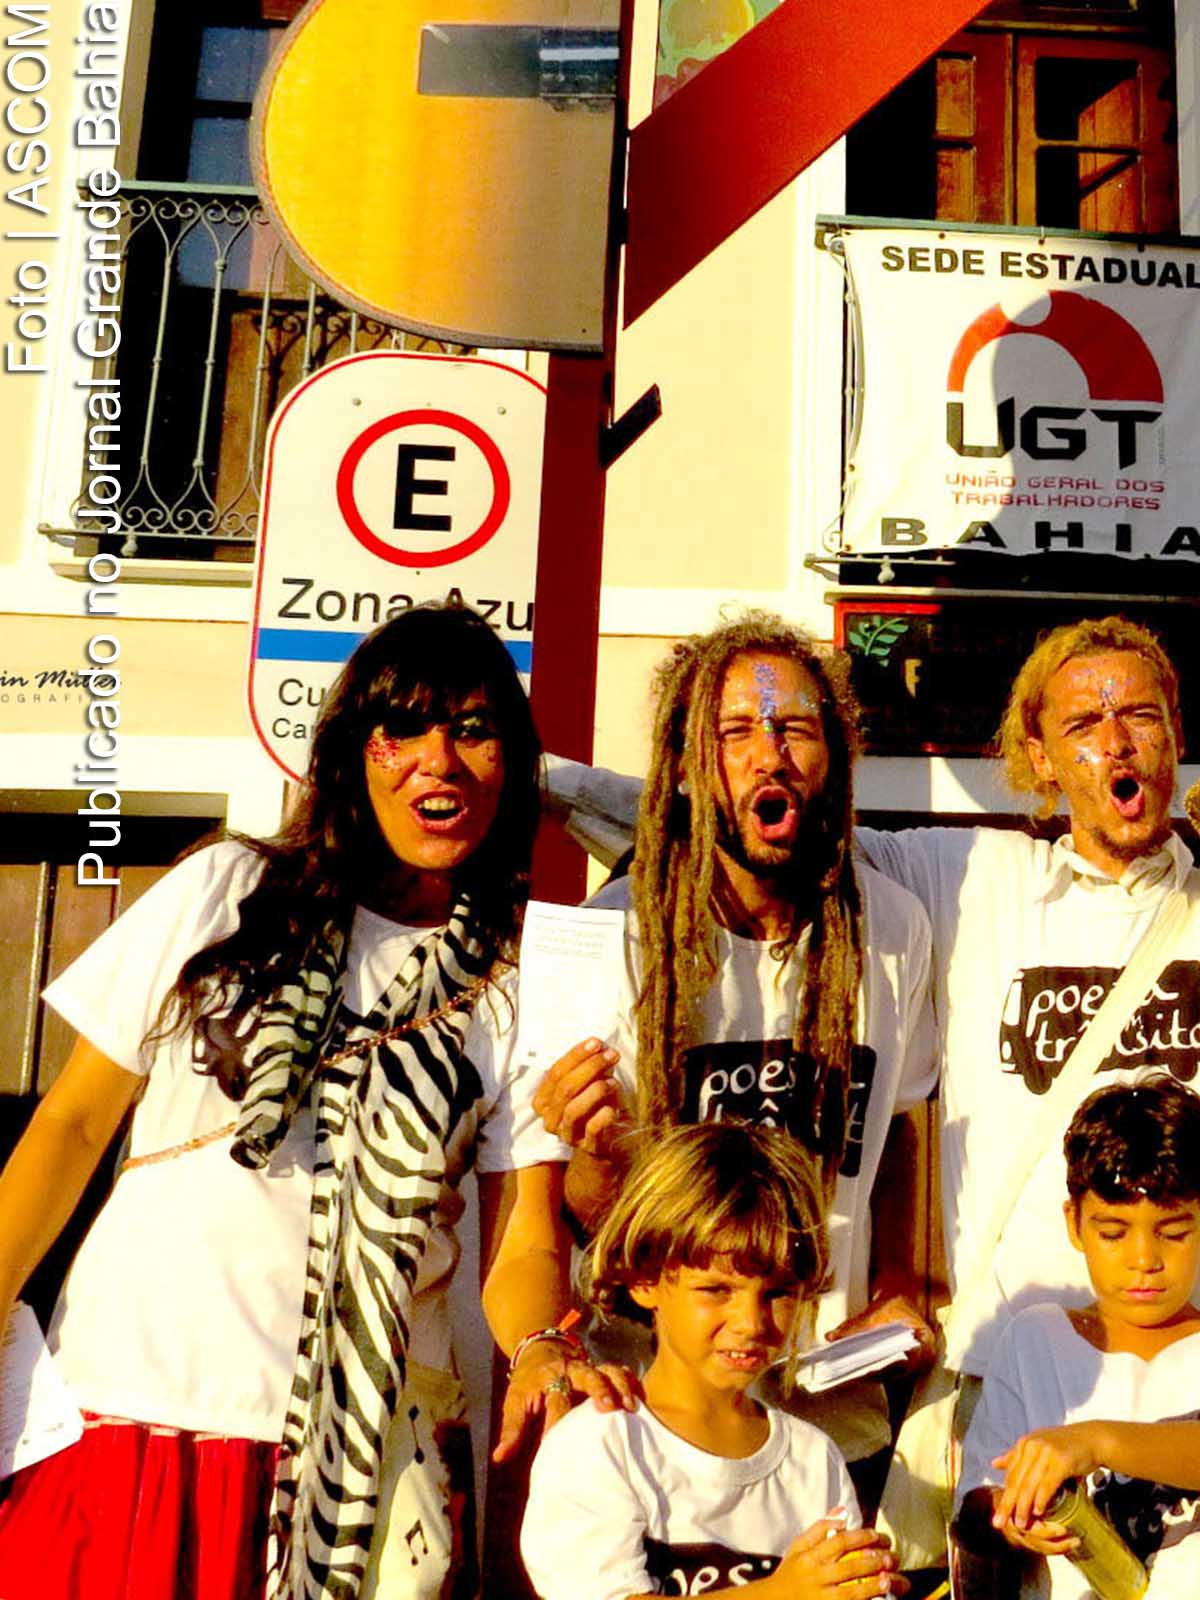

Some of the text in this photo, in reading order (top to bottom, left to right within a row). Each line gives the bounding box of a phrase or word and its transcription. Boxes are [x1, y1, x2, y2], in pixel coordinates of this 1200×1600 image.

[881, 245, 985, 275] SEDE
[946, 396, 1163, 470] UGT
[392, 443, 456, 532] E
[945, 470, 1166, 494] UNIÃO GERAL DOS
[951, 490, 1161, 511] TRABALHADORES
